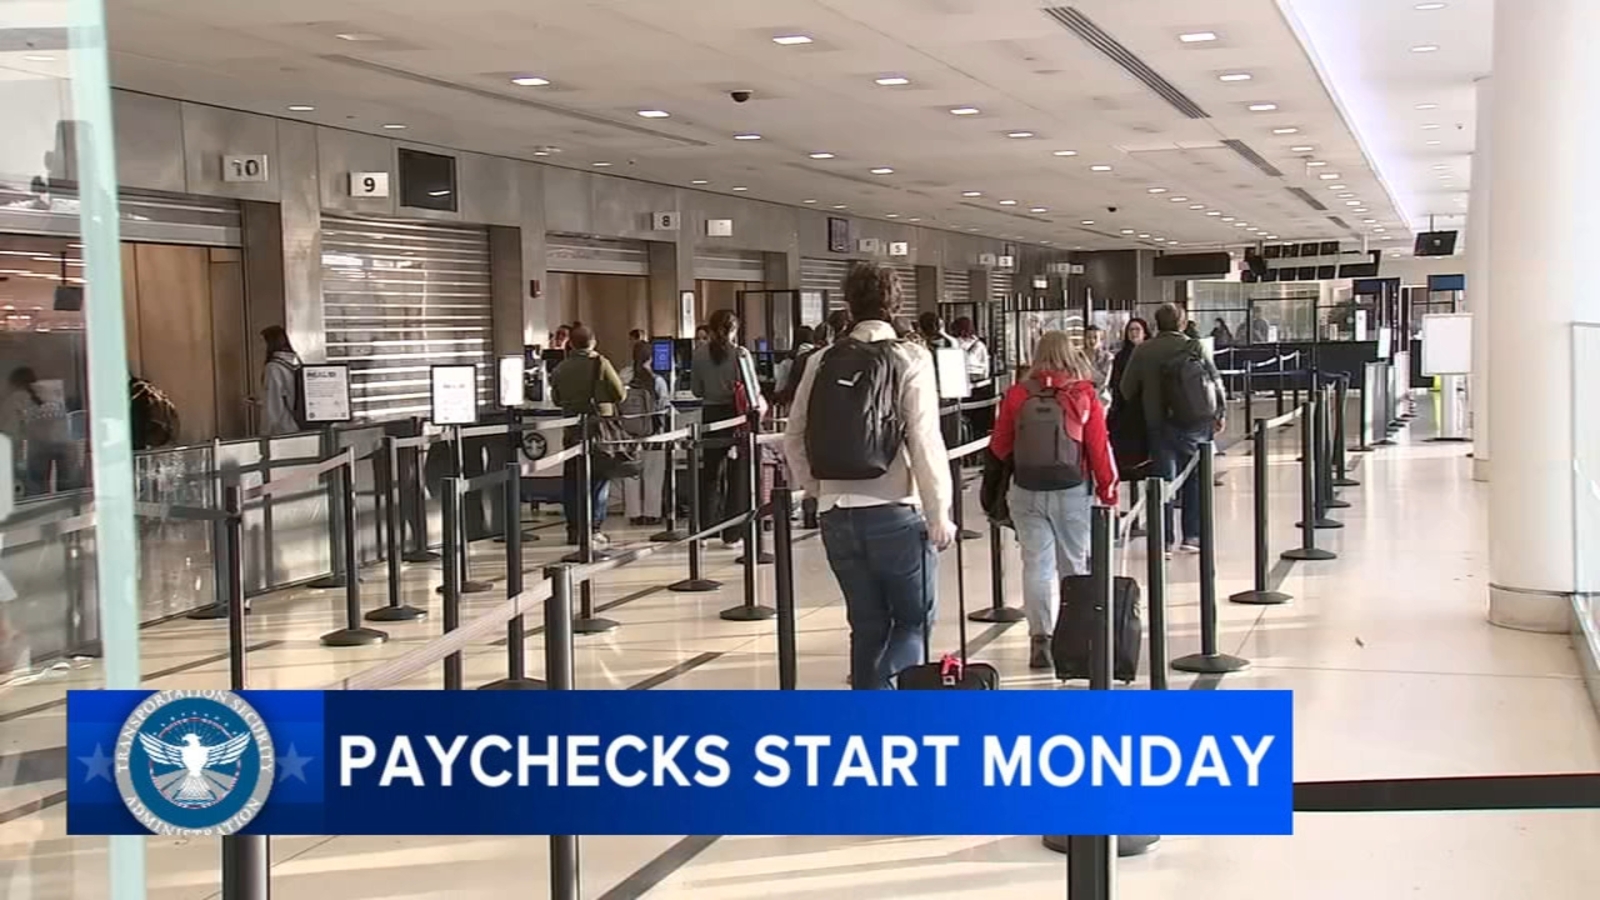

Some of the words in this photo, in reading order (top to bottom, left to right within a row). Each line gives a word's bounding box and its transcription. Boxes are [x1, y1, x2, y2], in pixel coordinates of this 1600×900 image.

[231, 159, 259, 176] 10
[363, 176, 375, 193] 9
[661, 214, 671, 228] 8
